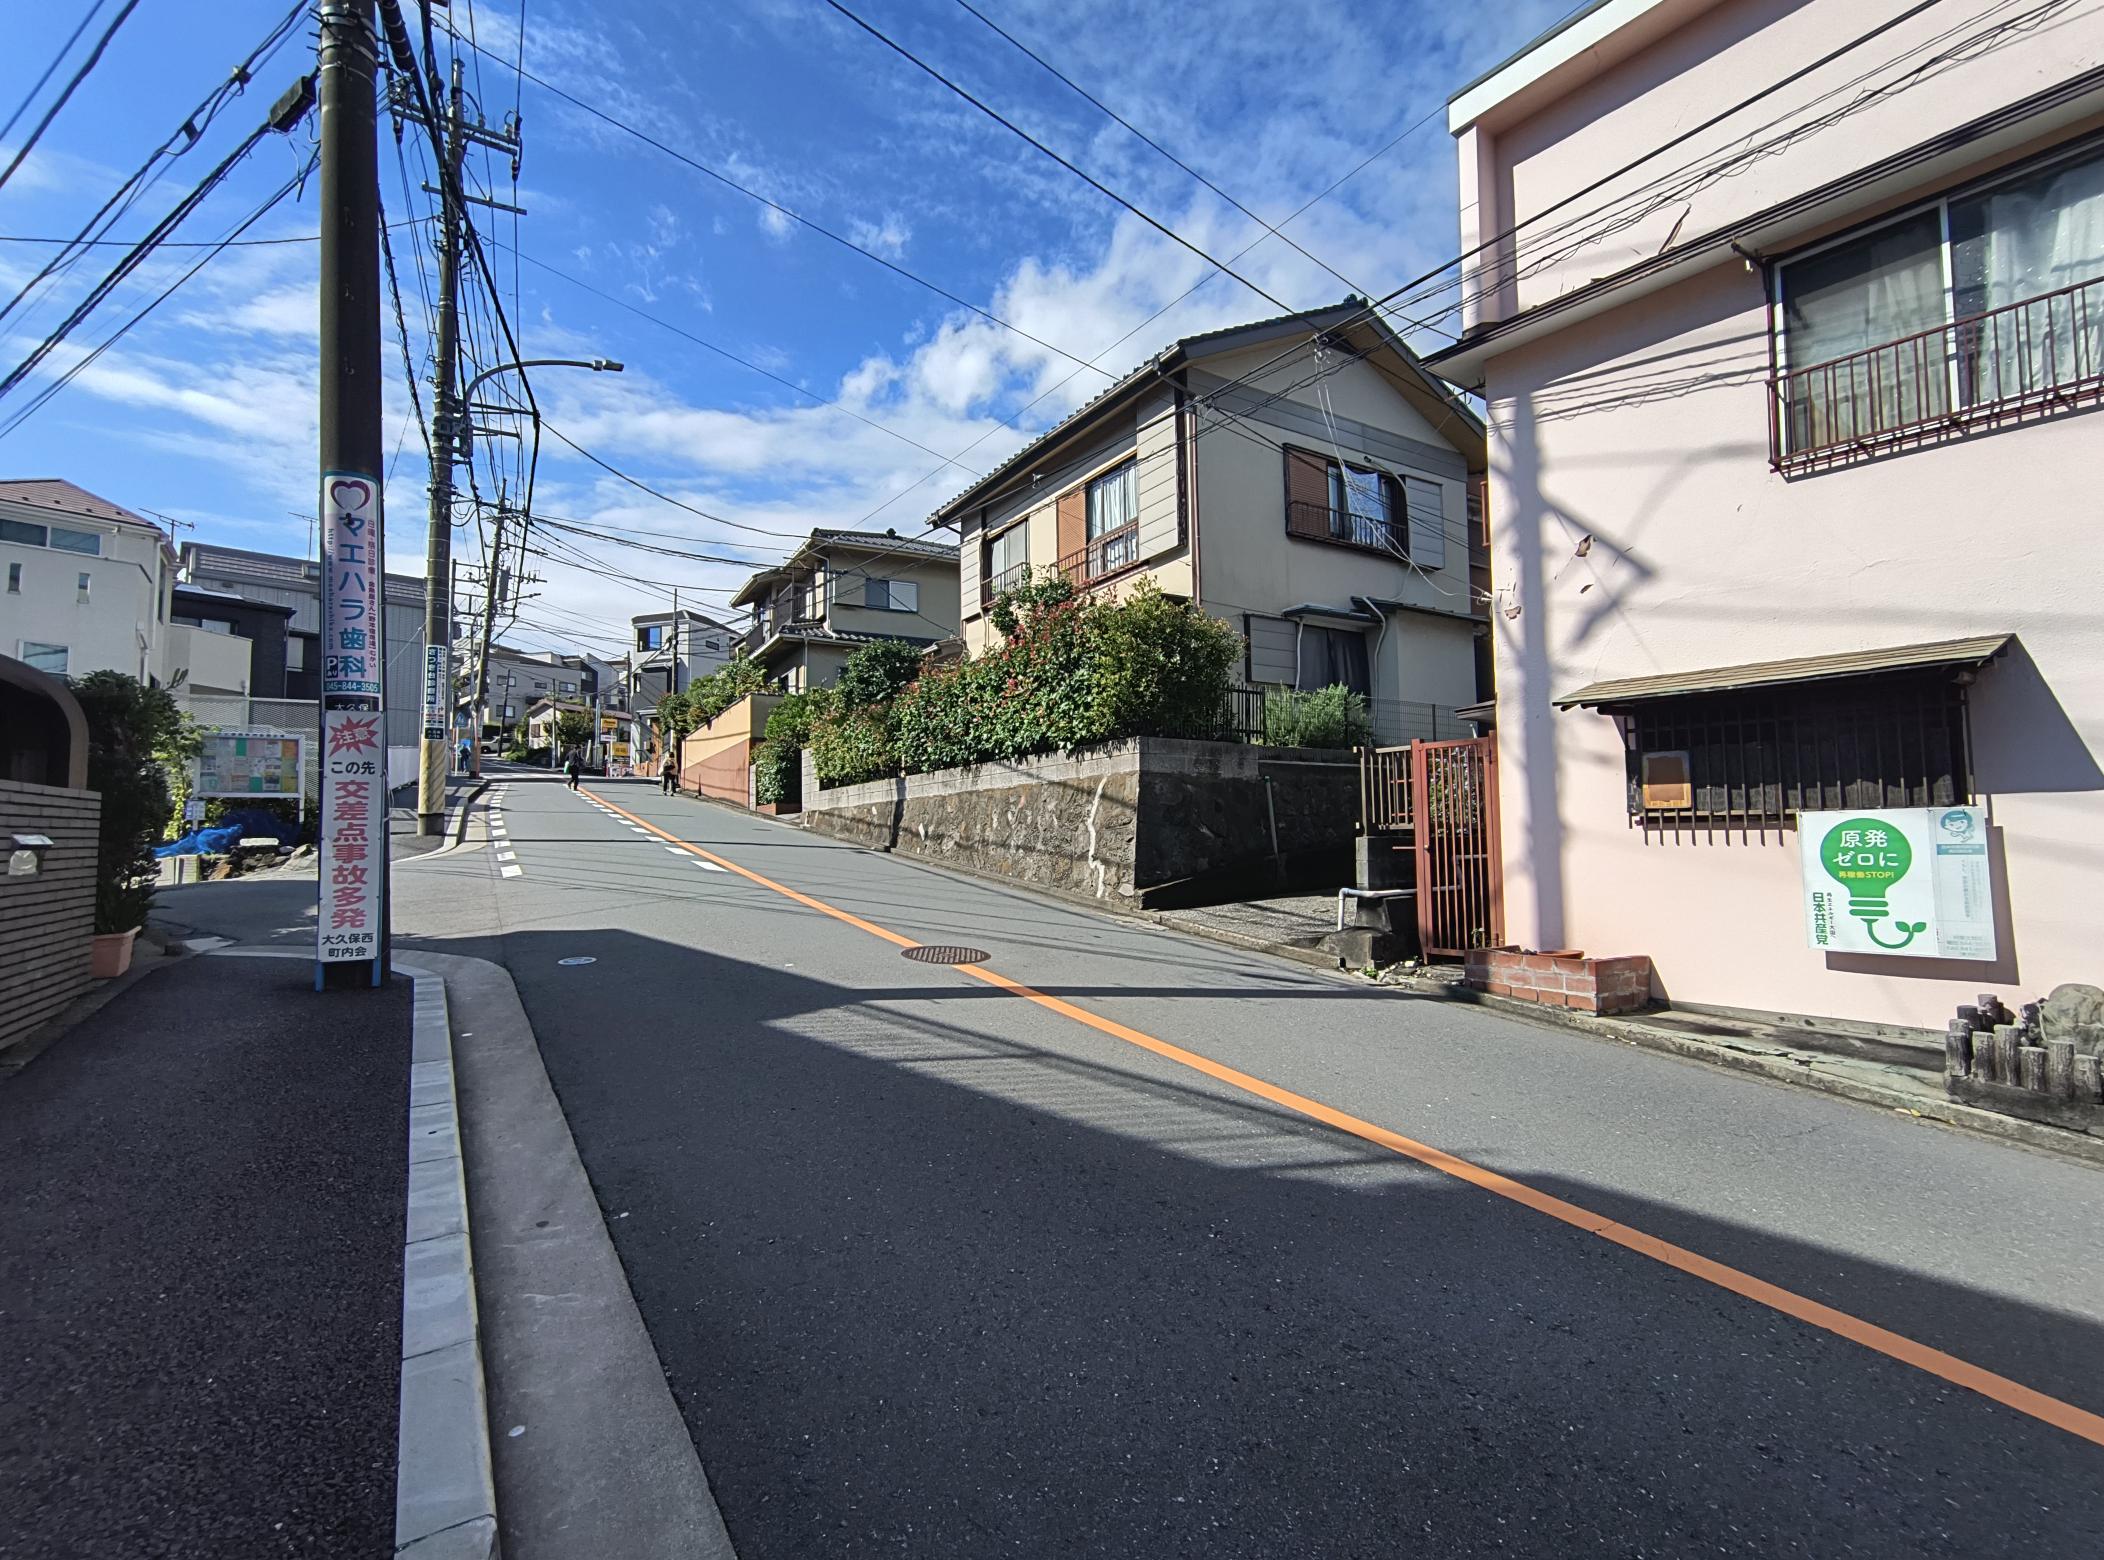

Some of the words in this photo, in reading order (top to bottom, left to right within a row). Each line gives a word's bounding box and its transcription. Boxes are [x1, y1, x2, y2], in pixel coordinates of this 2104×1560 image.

[338, 516, 367, 679] マエハラ歯科
[327, 657, 337, 668] P
[336, 727, 370, 744] 注意
[331, 761, 376, 775] この先
[1839, 829, 1888, 848] 原発
[331, 779, 370, 929] 交差点事故多発
[1832, 851, 1899, 867] ゼロに
[1812, 892, 1829, 945] 日本共産党
[321, 933, 374, 946] 大久保西
[328, 946, 367, 958] 町内会
